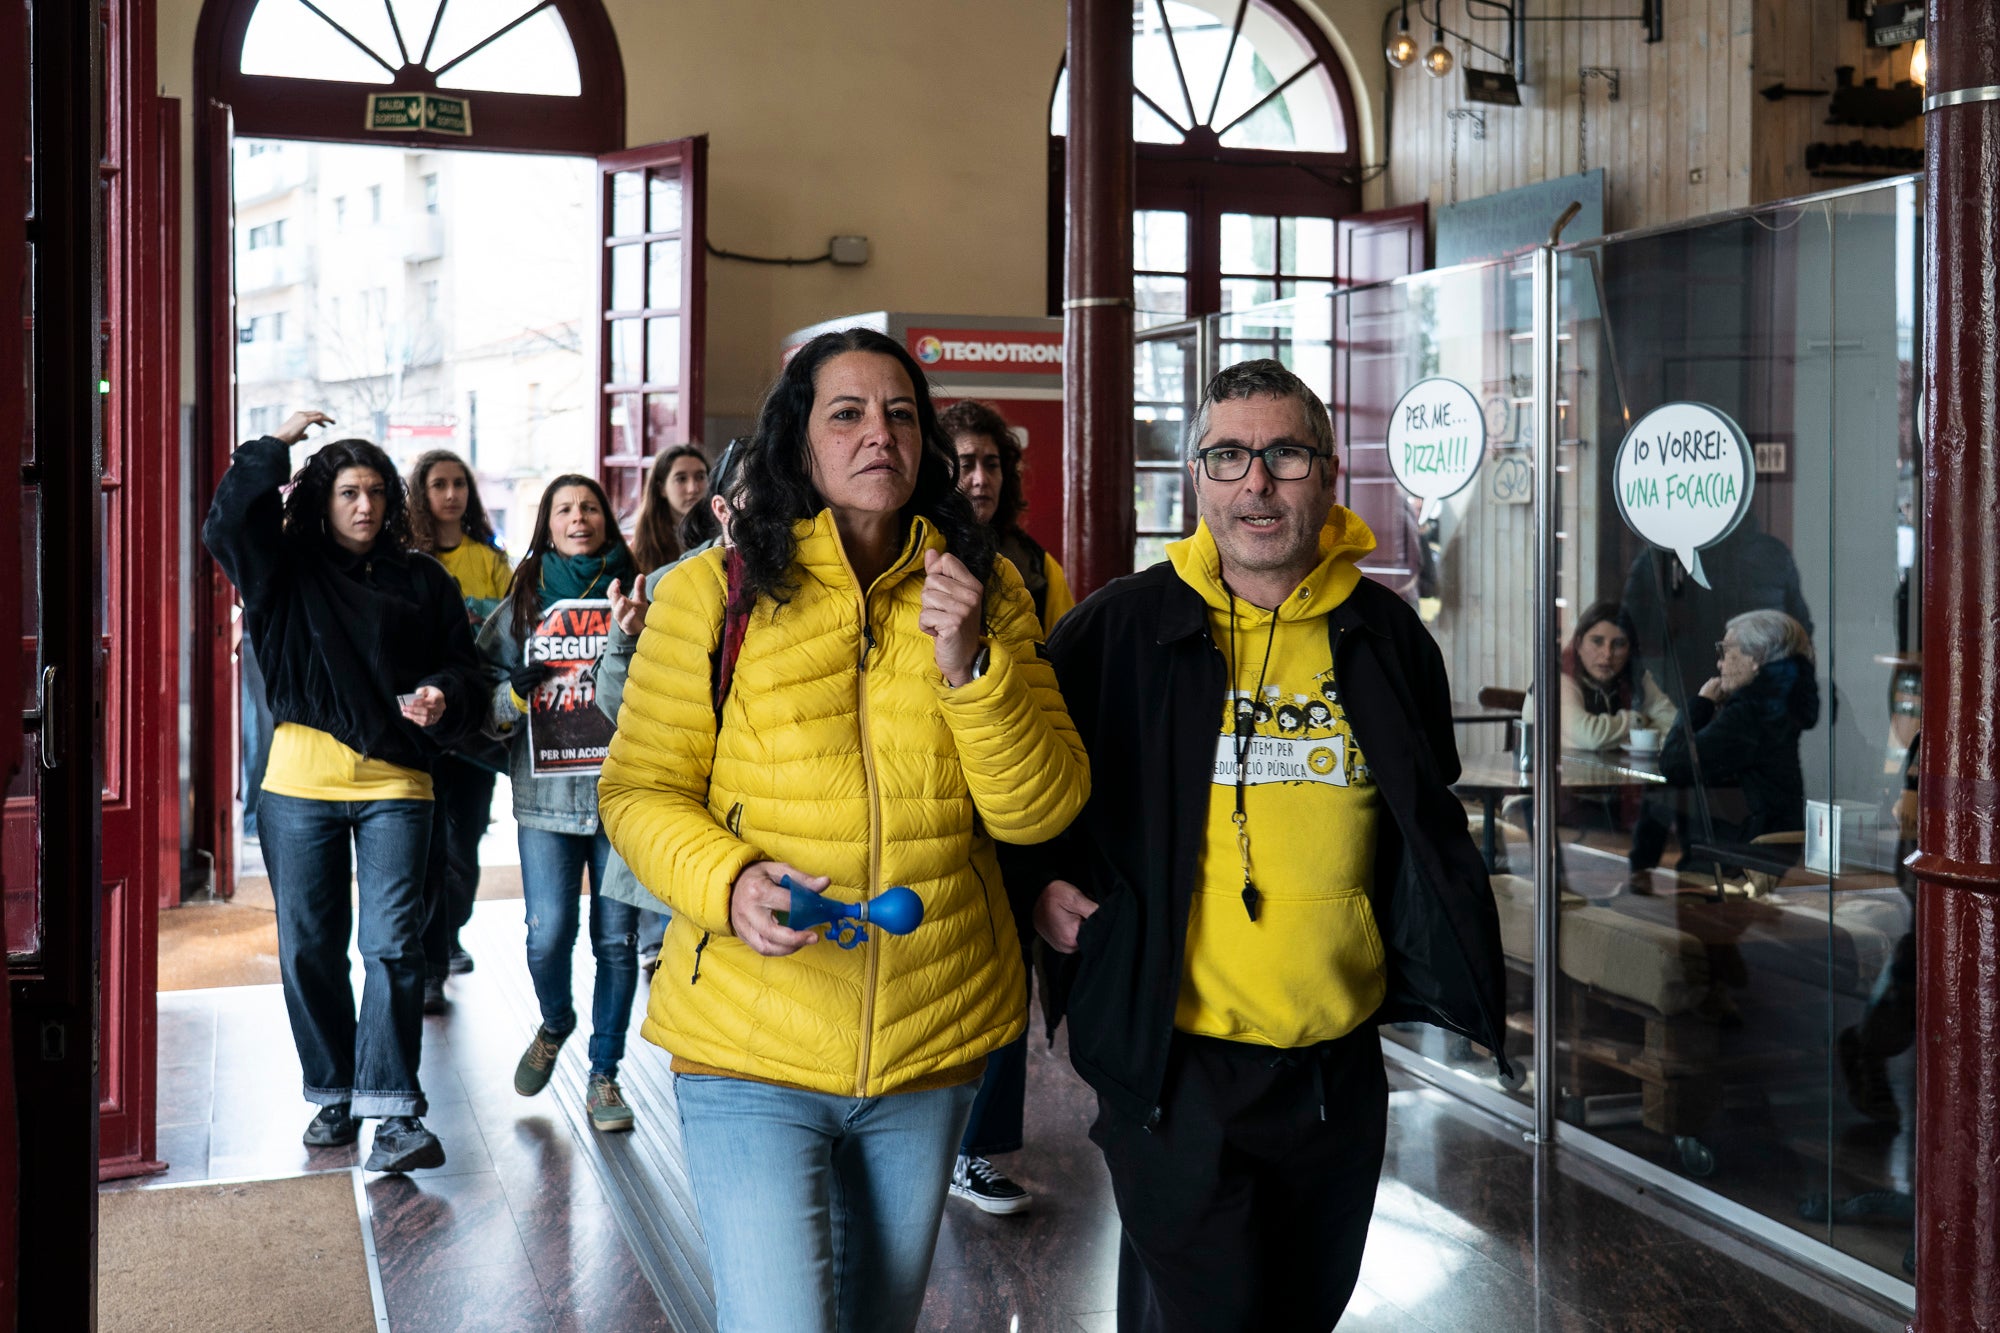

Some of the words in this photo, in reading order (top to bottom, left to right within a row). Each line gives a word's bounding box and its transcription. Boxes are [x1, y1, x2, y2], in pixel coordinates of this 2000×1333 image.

[378, 99, 406, 112] SALIDA
[374, 113, 409, 125] SORTIDA
[942, 341, 1063, 363] TECNOTRON
[1405, 404, 1429, 432] PER
[1431, 402, 1467, 429] ME...
[1404, 436, 1468, 477] PIZZA!!!
[1657, 429, 1727, 466] VORREI:
[1626, 476, 1660, 509] UNA
[1665, 472, 1737, 511] FOCACCIA
[535, 610, 567, 636] LA
[540, 749, 560, 761] PER
[562, 748, 576, 759] UN
[1277, 742, 1294, 757] PER
[1267, 759, 1308, 778] PÚBLICA
